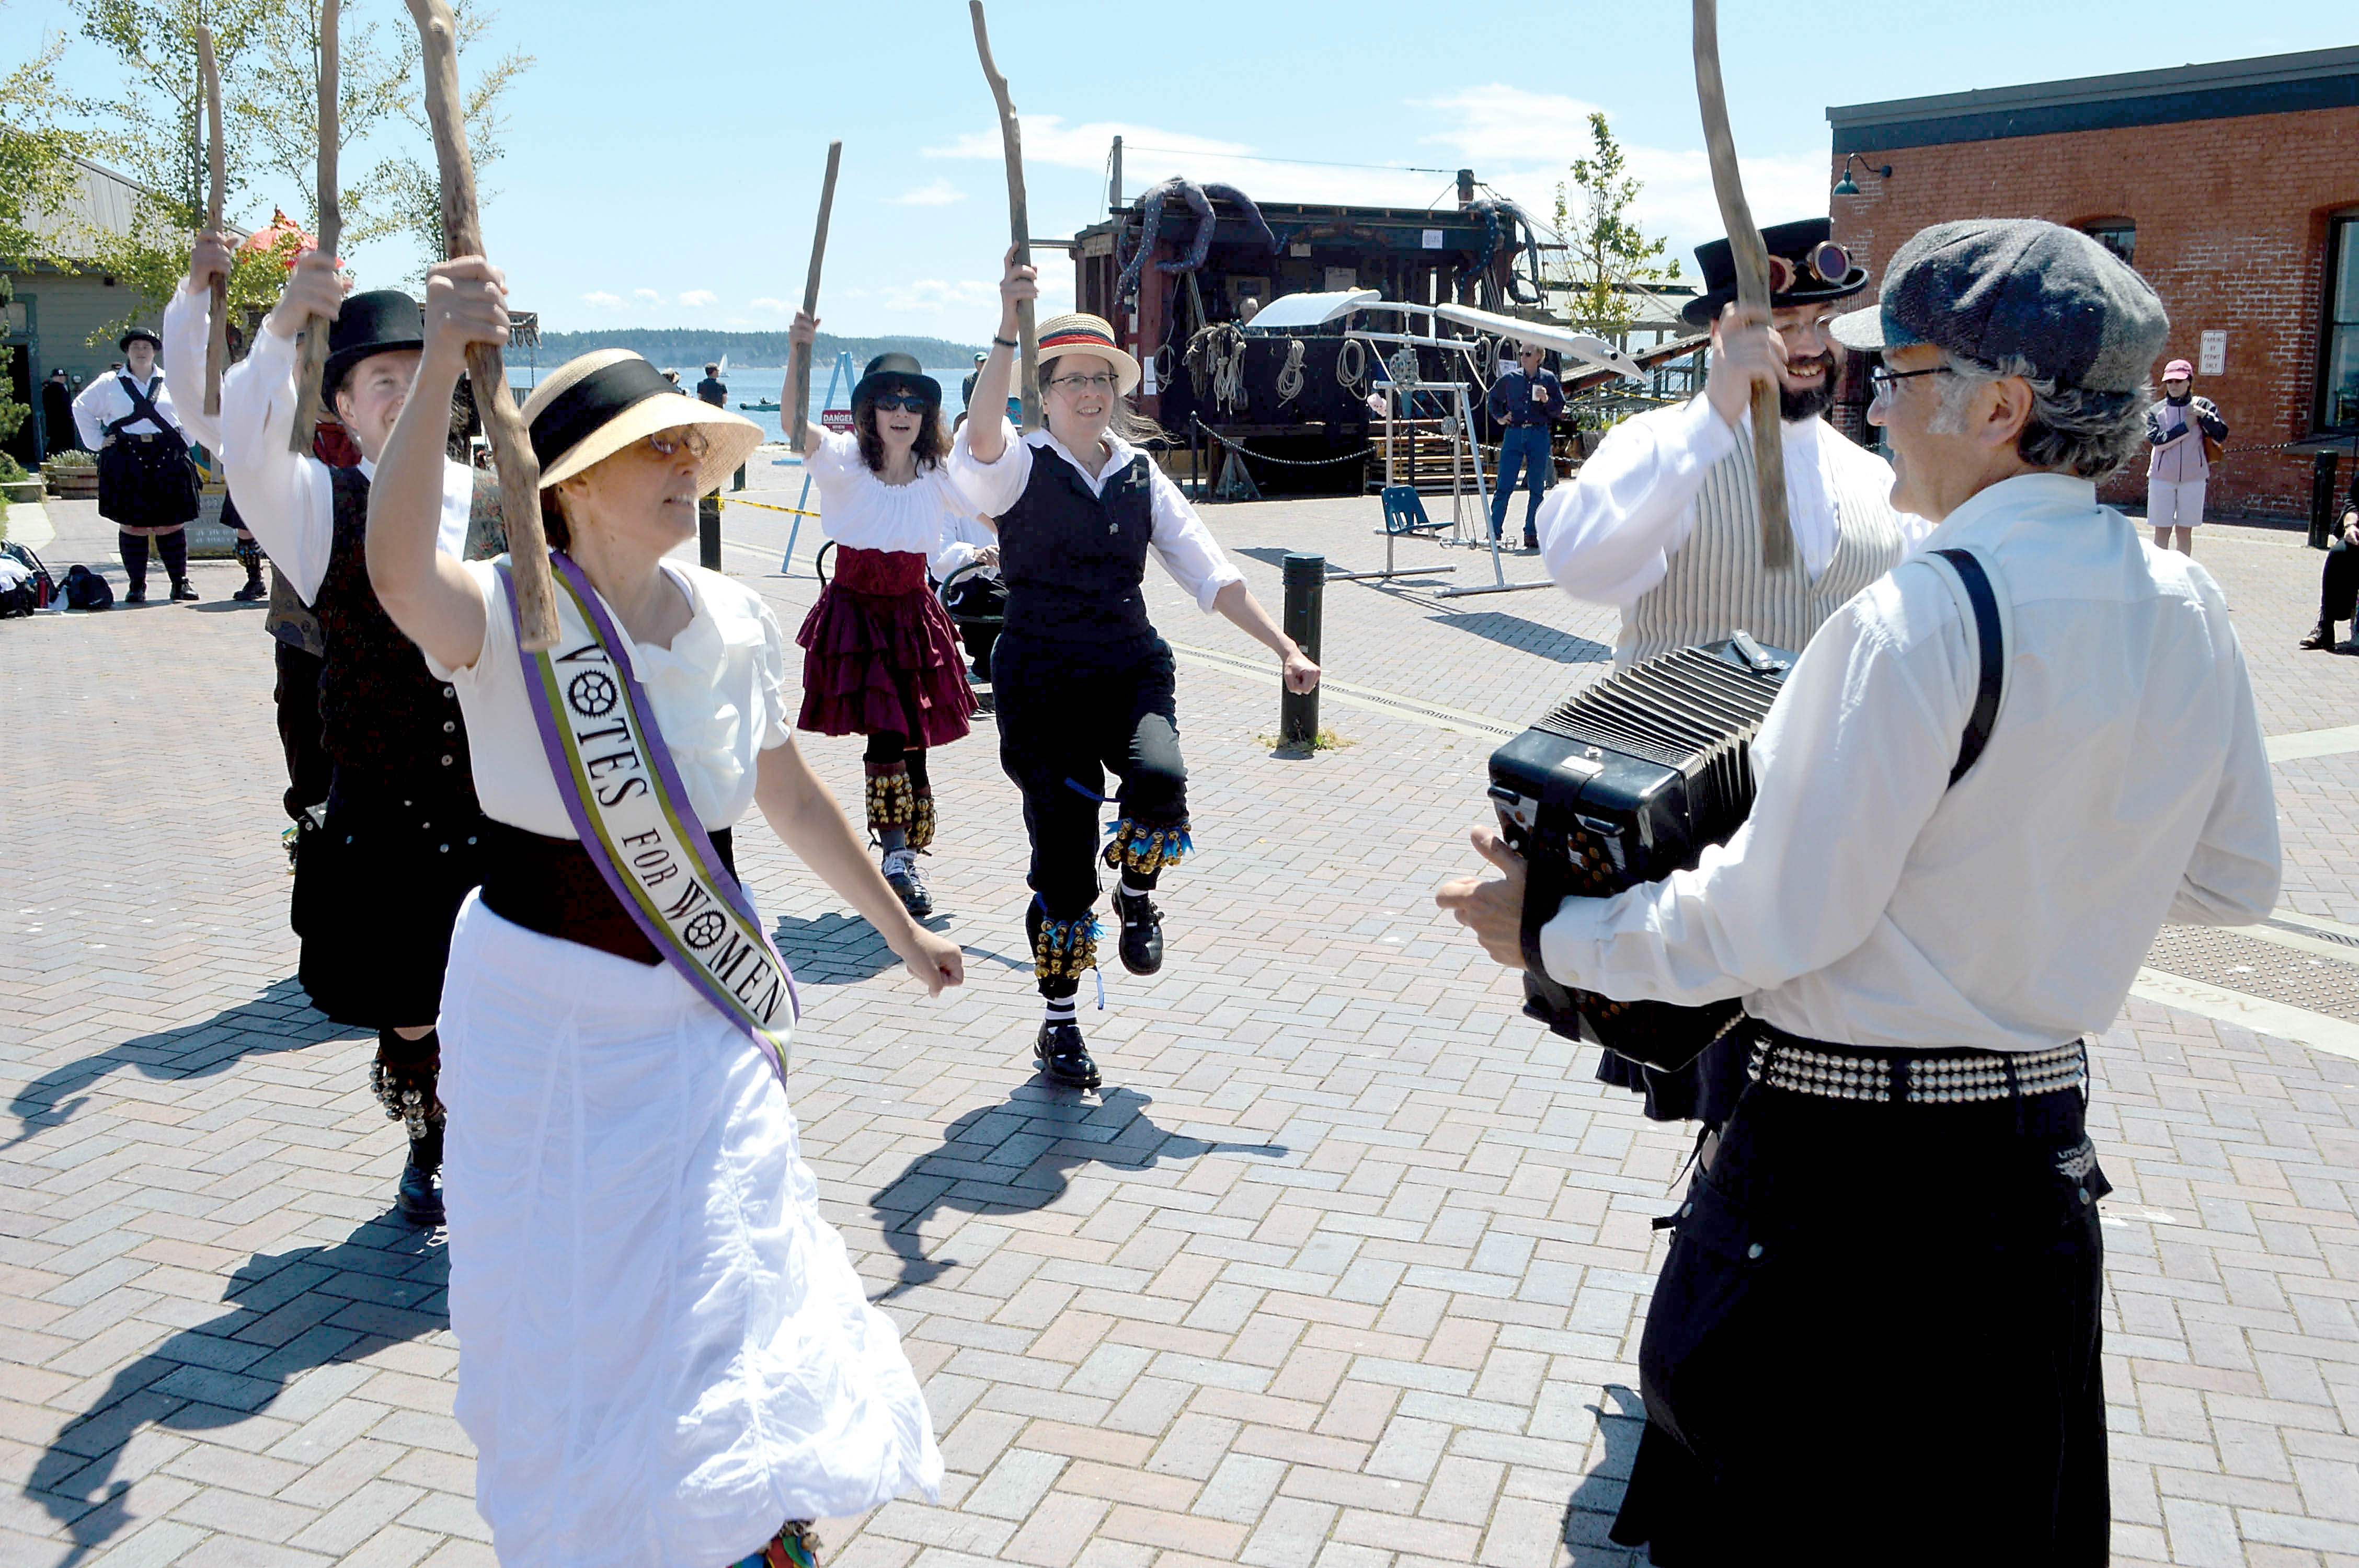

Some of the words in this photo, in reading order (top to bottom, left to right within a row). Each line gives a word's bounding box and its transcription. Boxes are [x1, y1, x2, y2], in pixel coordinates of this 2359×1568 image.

[556, 643, 648, 806] VOTES
[622, 827, 679, 887] FOR
[661, 877, 786, 1025] WOMEN
